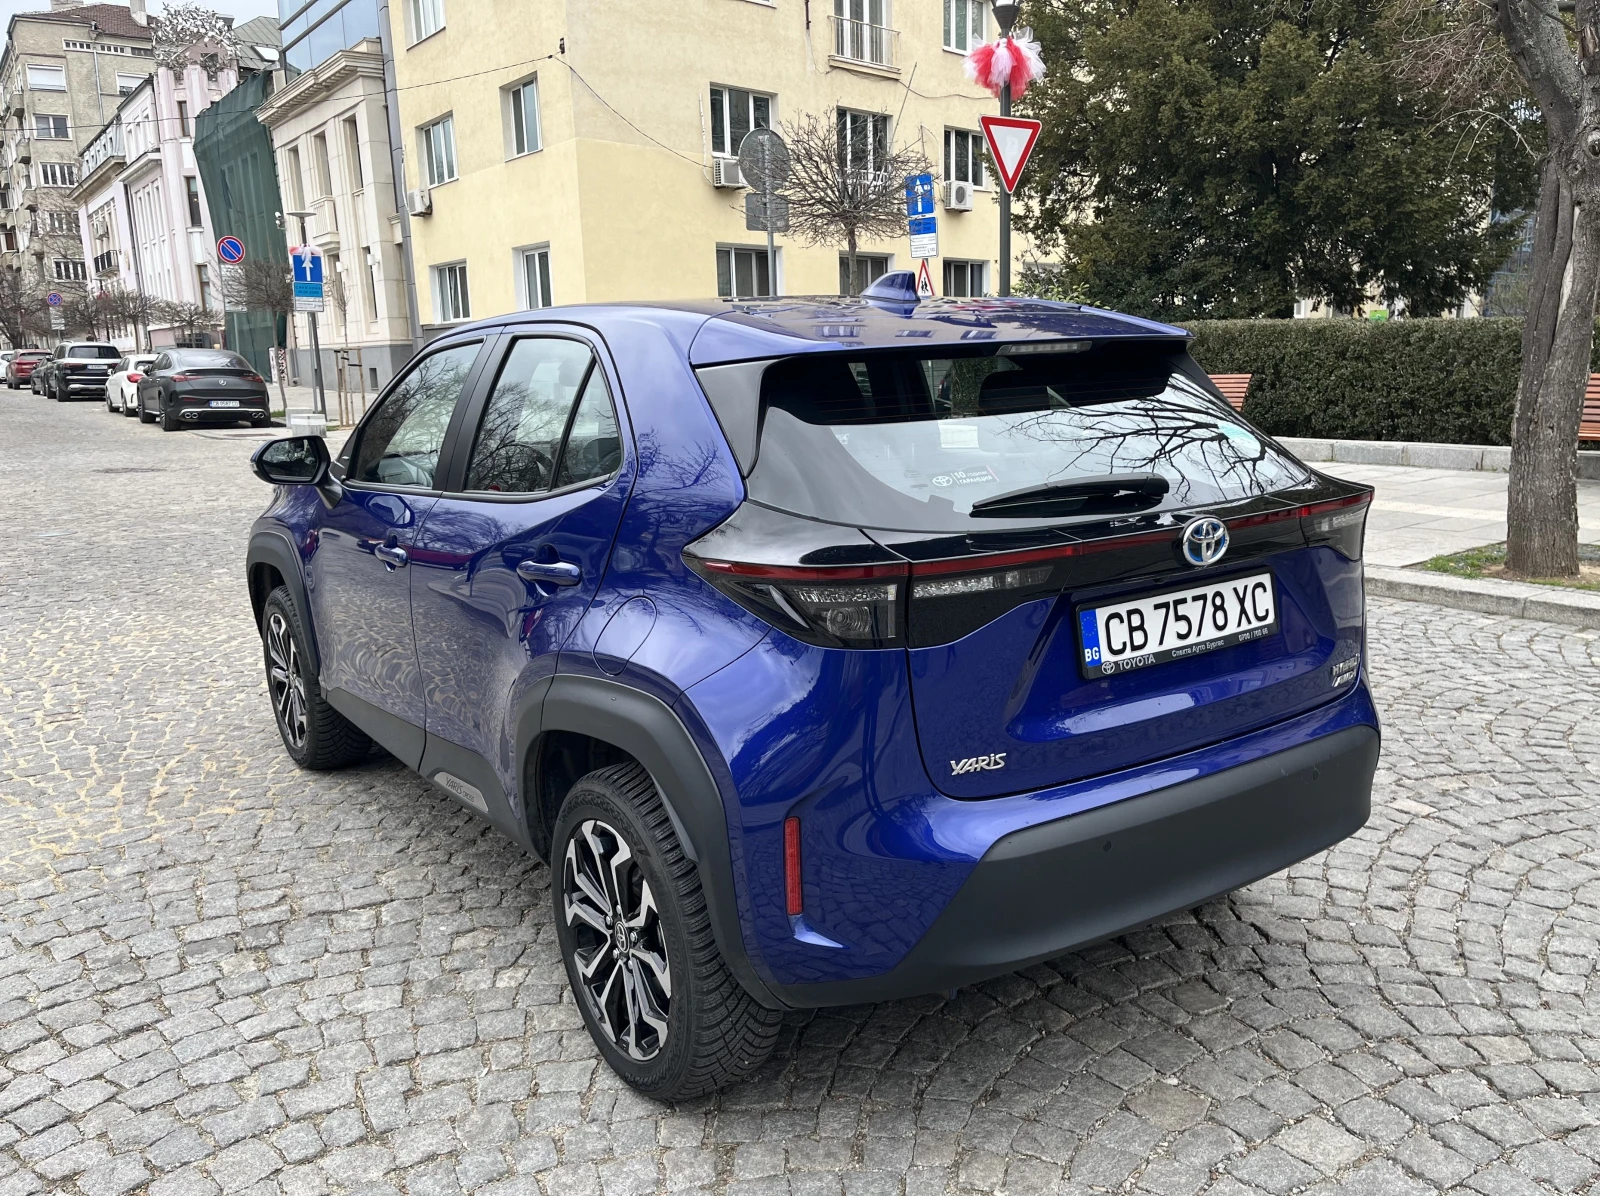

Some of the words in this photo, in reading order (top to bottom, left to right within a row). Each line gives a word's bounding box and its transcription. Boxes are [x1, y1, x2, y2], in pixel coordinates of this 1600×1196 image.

[954, 471, 966, 479] 10
[959, 475, 993, 485] ГАРАНЦИЯ
[1105, 607, 1149, 656] CB
[1153, 590, 1229, 646] 7578
[1232, 581, 1270, 628] XC
[1084, 646, 1100, 662] BG
[1192, 644, 1206, 654] Ауто
[1117, 653, 1156, 671] TOYOTA
